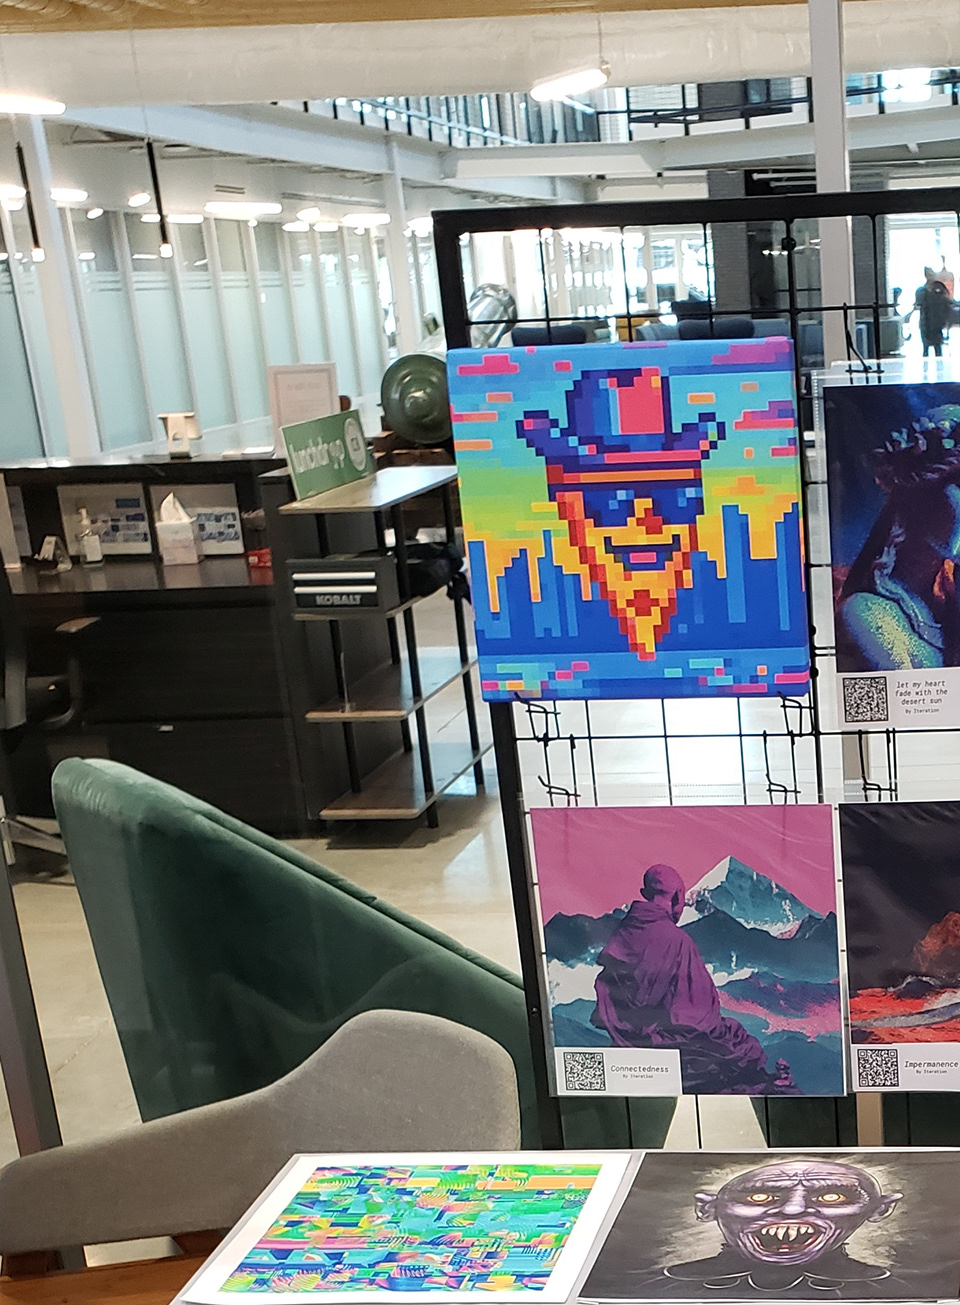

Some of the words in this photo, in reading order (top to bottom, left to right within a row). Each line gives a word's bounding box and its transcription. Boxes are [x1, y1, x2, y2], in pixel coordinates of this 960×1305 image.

[315, 594, 361, 605] KOBALT
[896, 681, 909, 689] let
[925, 680, 946, 688] heart
[901, 698, 926, 706] desert
[610, 1064, 669, 1073] Connectedness
[904, 1060, 959, 1069] Impermanence
